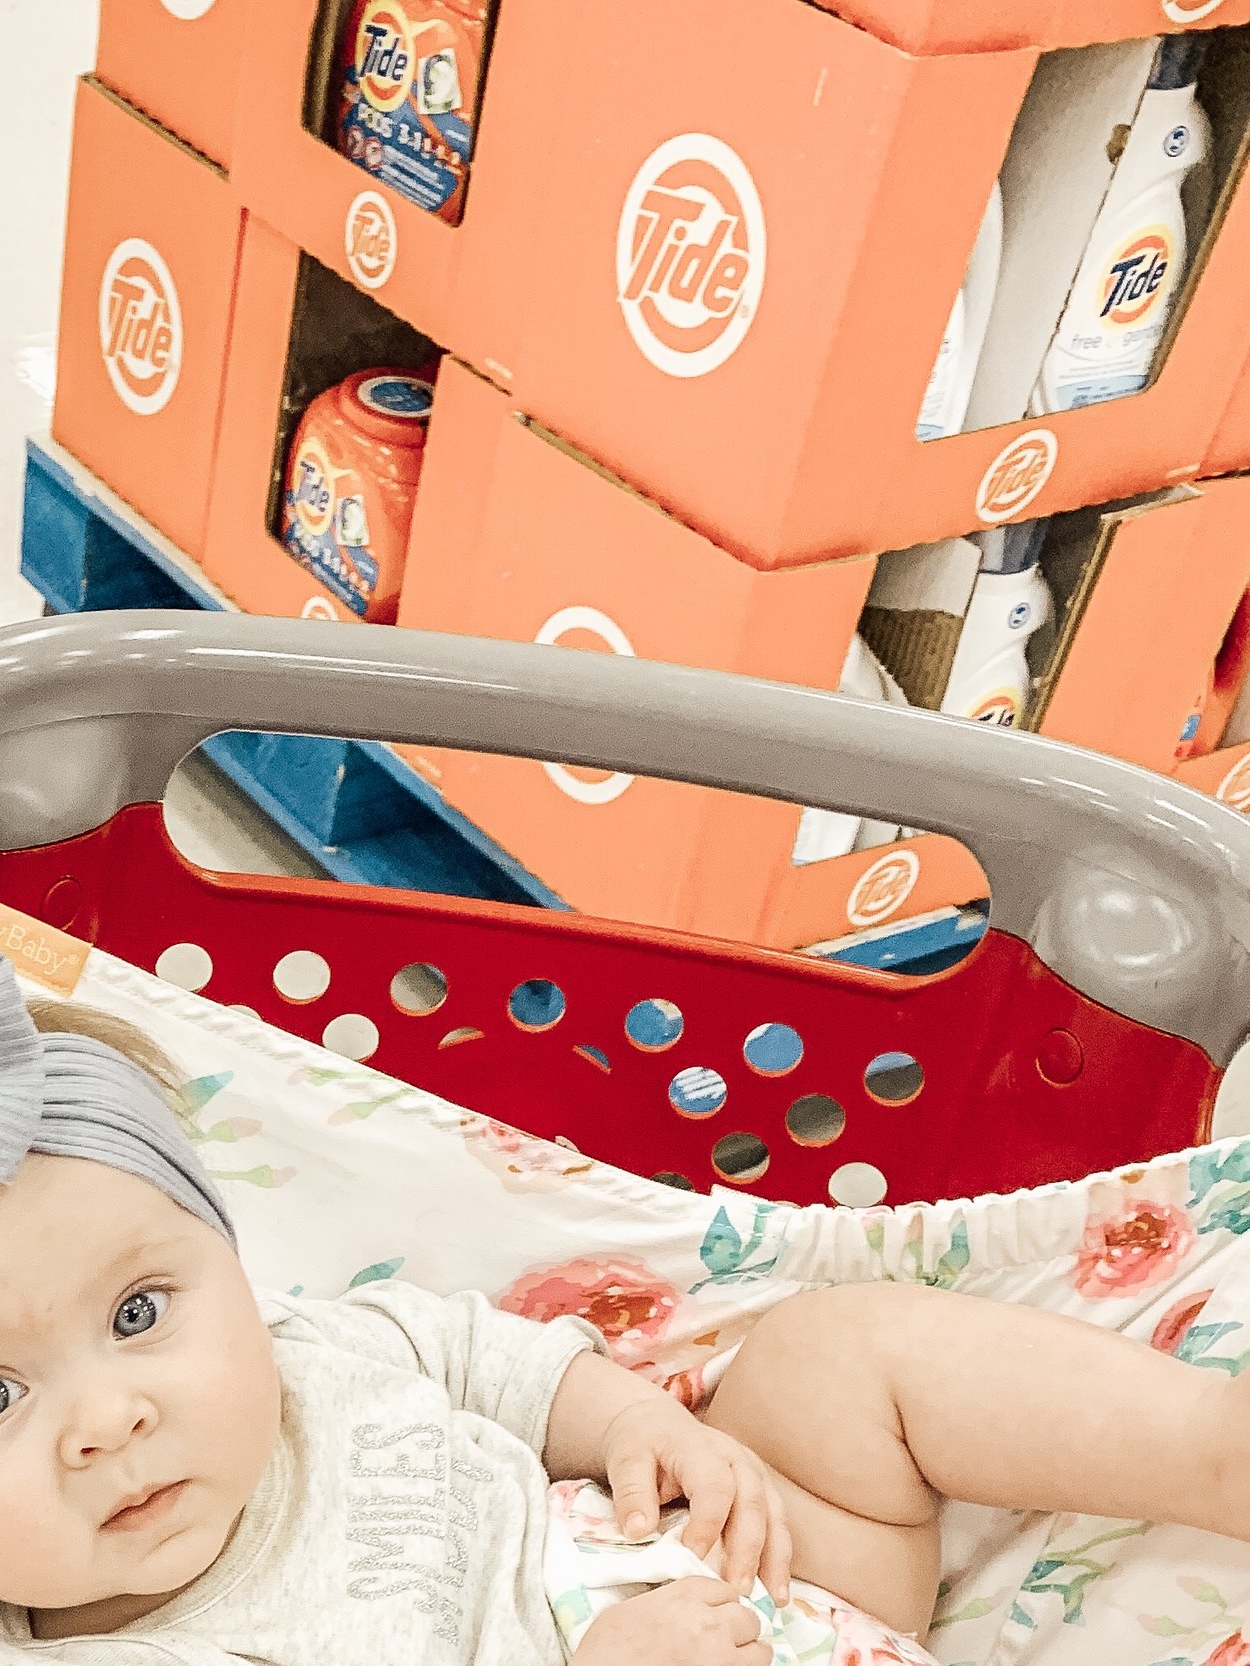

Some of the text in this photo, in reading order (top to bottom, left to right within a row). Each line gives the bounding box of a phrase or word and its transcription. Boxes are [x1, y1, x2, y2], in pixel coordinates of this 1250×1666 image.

[360, 24, 408, 81] Tide
[621, 189, 750, 314] Tide
[1099, 252, 1168, 317] Tide
[104, 279, 173, 368] Tide
[345, 1422, 465, 1615] SMILES
